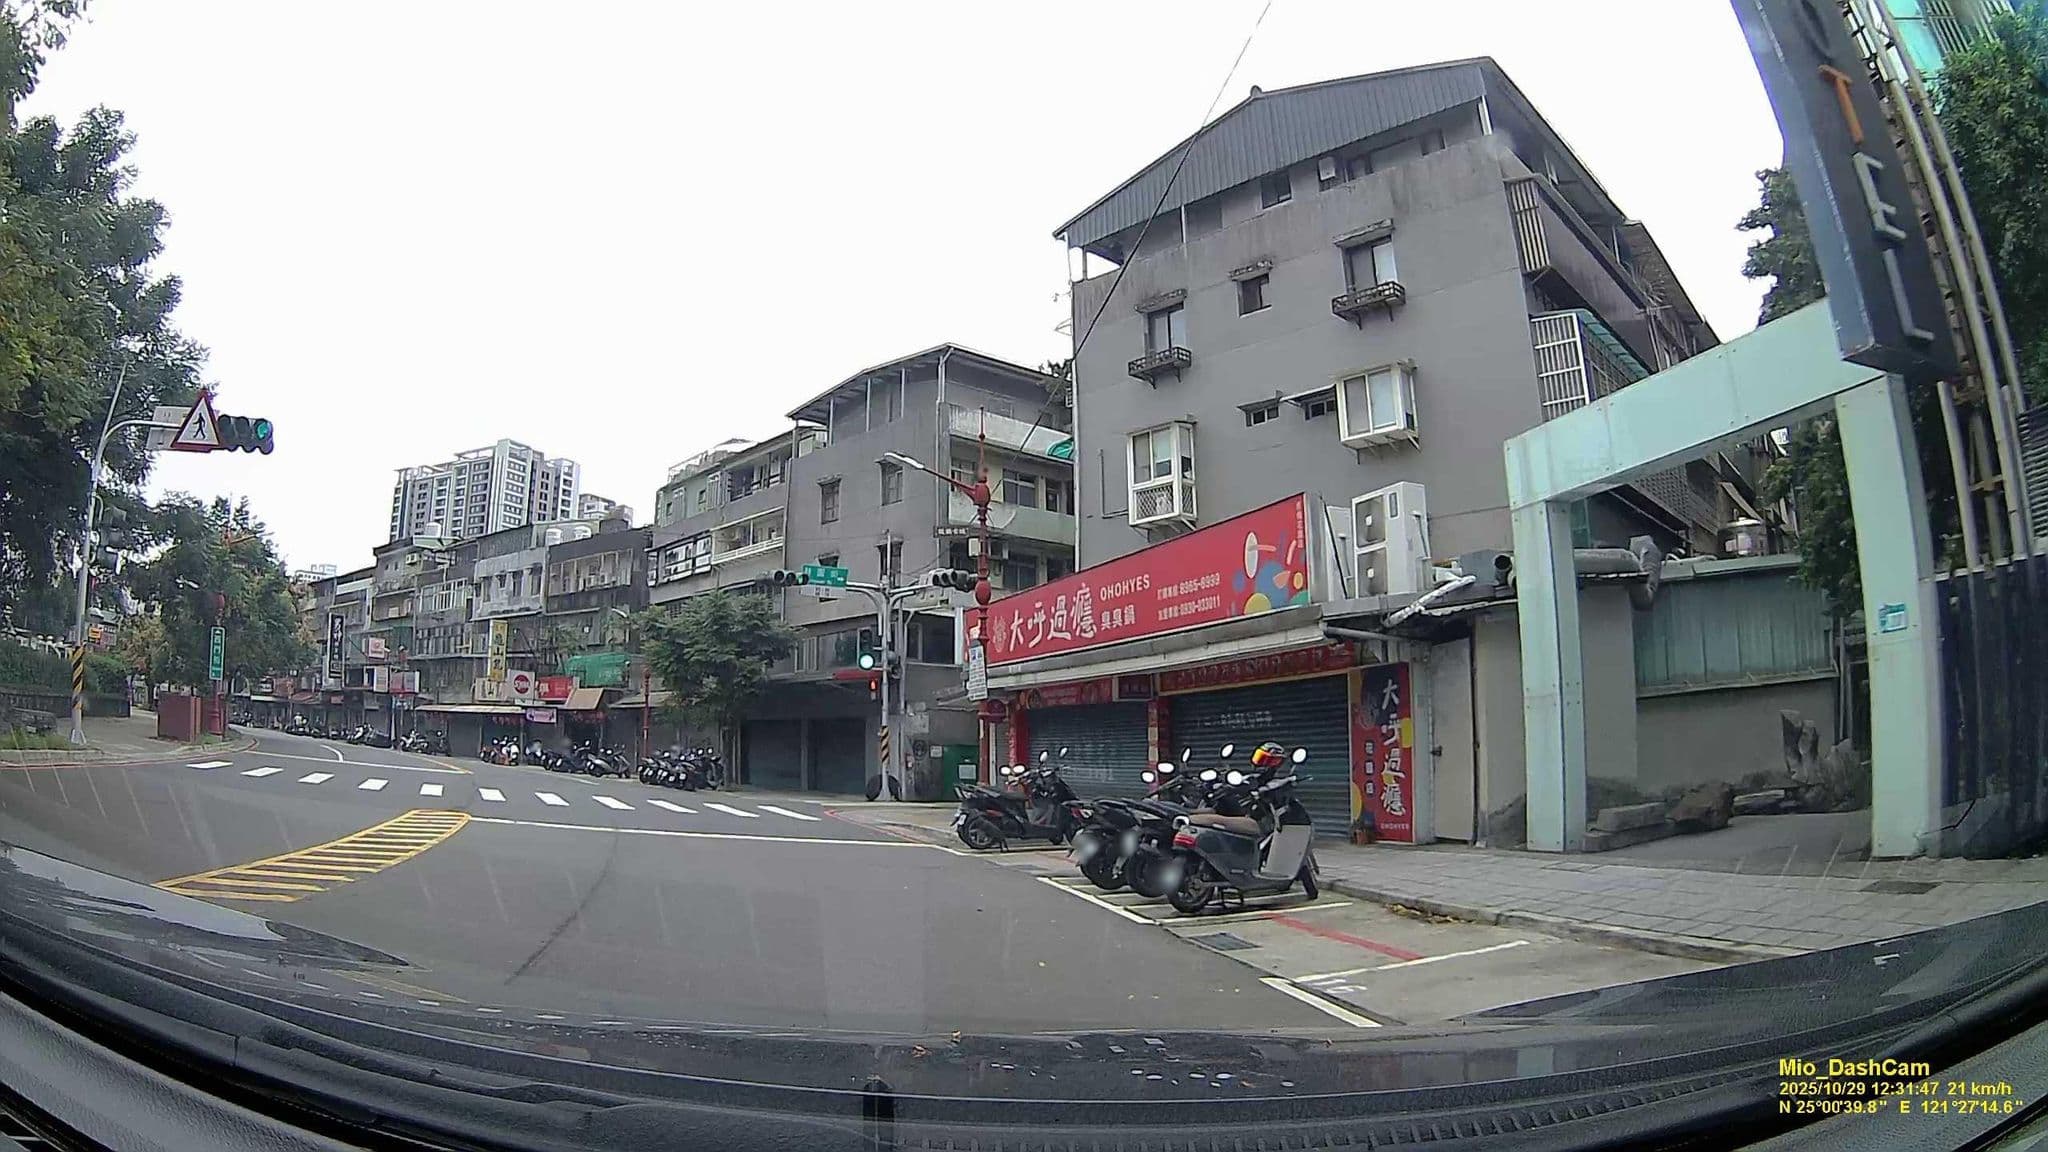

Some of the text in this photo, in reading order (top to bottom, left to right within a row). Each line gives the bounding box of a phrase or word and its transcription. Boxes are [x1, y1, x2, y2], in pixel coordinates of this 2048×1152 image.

[1099, 574, 1150, 601] OHOHYES
[1009, 582, 1097, 652] 大呼過癮
[1100, 604, 1135, 631] 臭臭鍋
[1380, 678, 1406, 817] 大呼過癮
